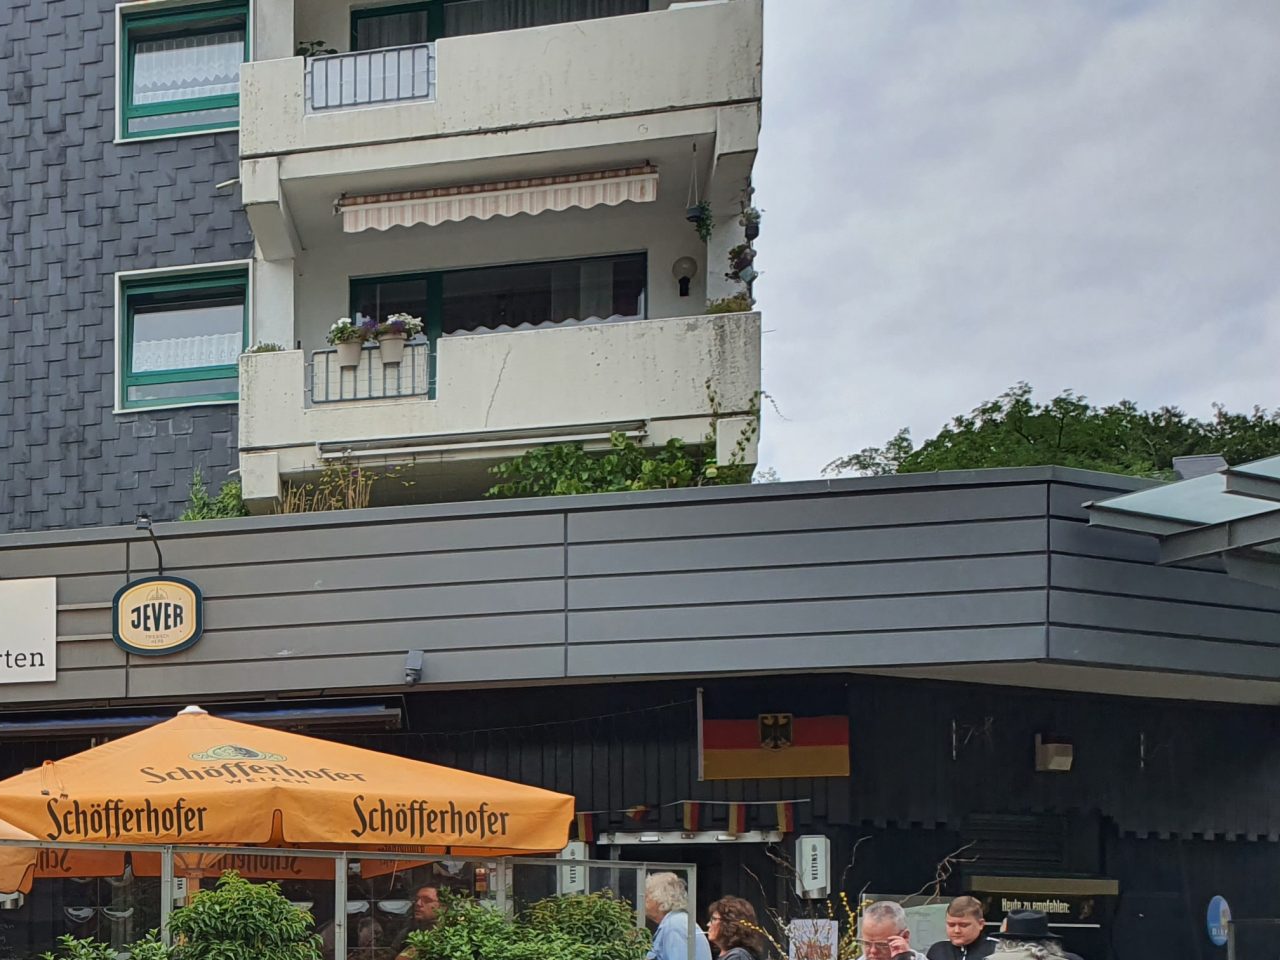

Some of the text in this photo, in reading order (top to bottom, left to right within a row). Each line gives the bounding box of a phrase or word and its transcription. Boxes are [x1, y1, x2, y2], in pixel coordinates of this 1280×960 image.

[131, 602, 184, 632] JEVER
[140, 761, 368, 784] Schöfferhofer
[46, 797, 208, 841] Schöfferhofer
[351, 795, 510, 840] Schöfferhofer
[811, 852, 819, 881] VELTINS
